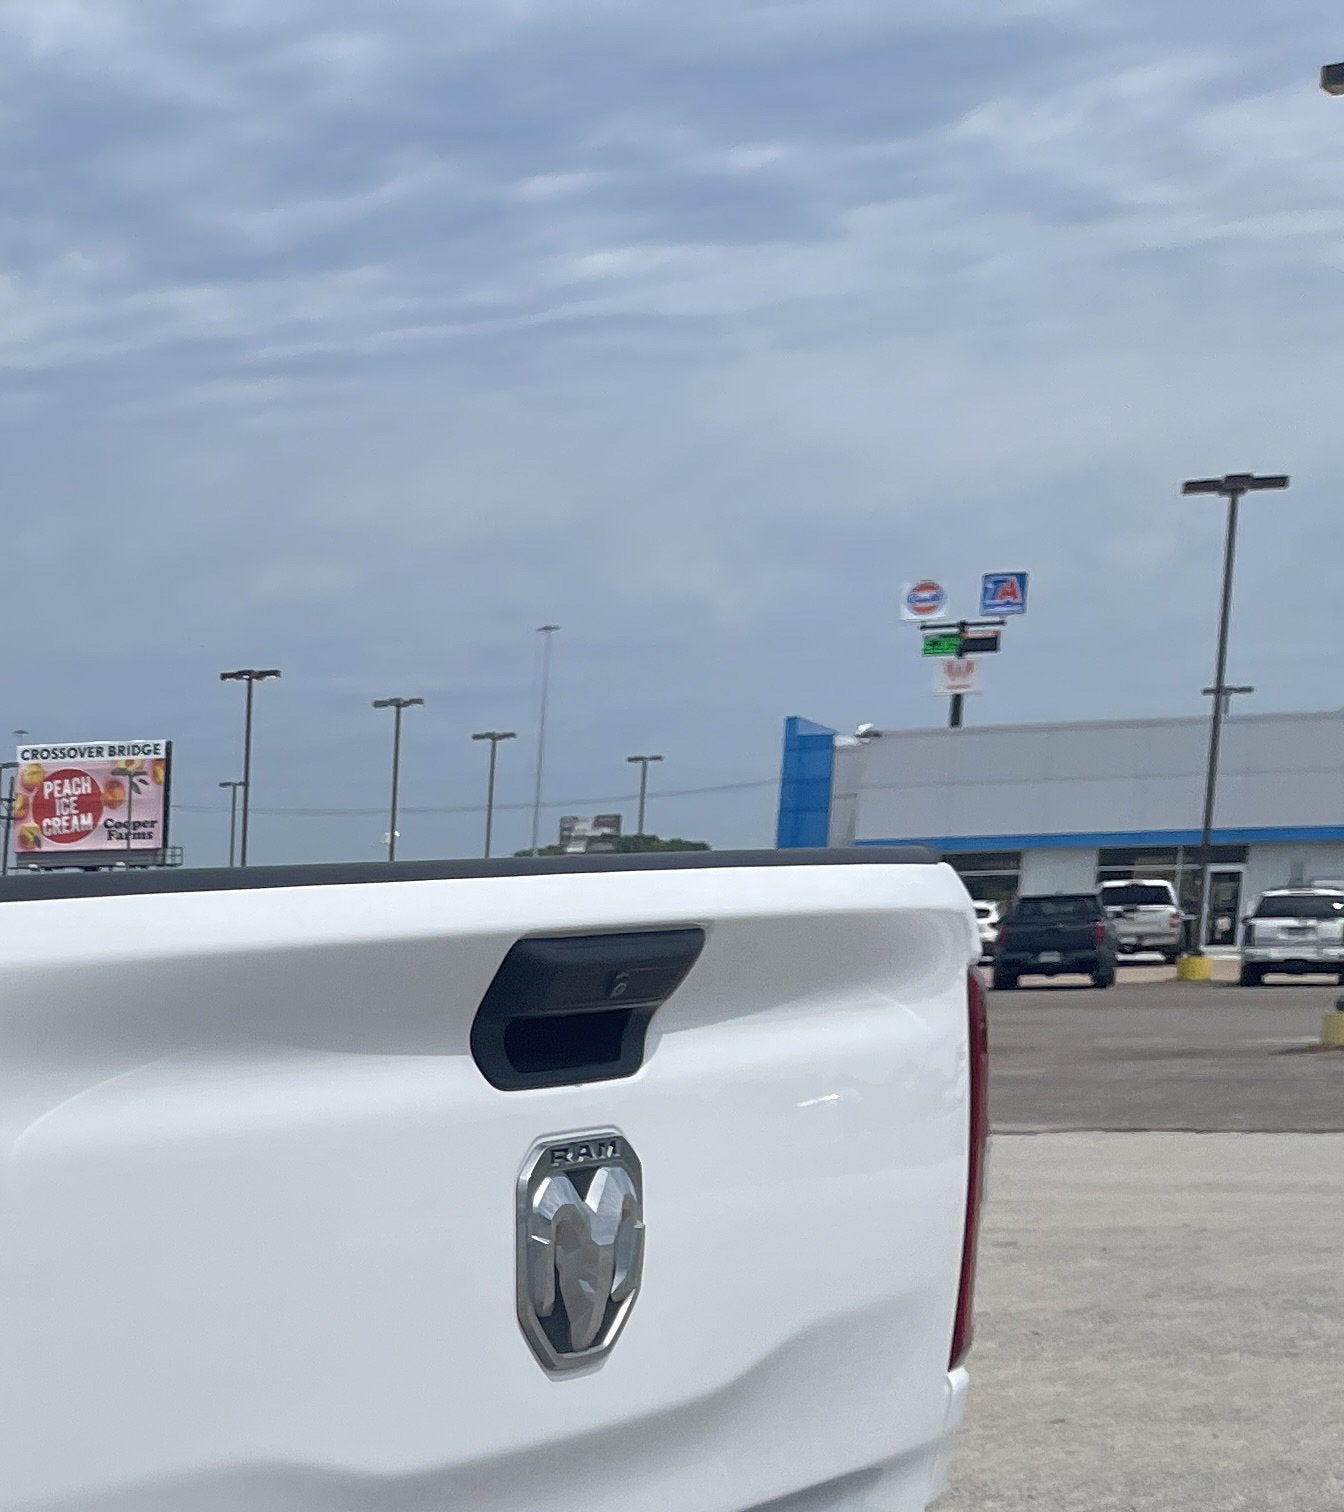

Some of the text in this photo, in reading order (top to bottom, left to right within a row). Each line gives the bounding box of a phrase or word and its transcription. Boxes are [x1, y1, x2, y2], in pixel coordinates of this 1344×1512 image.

[20, 743, 161, 761] CROSSOVER BRIDGE
[43, 776, 92, 800] PEACH
[55, 797, 79, 816] ICE
[42, 812, 93, 837] CREAM
[103, 818, 158, 831] Cooper
[107, 829, 154, 841] Farms
[550, 1141, 621, 1167] RAM
